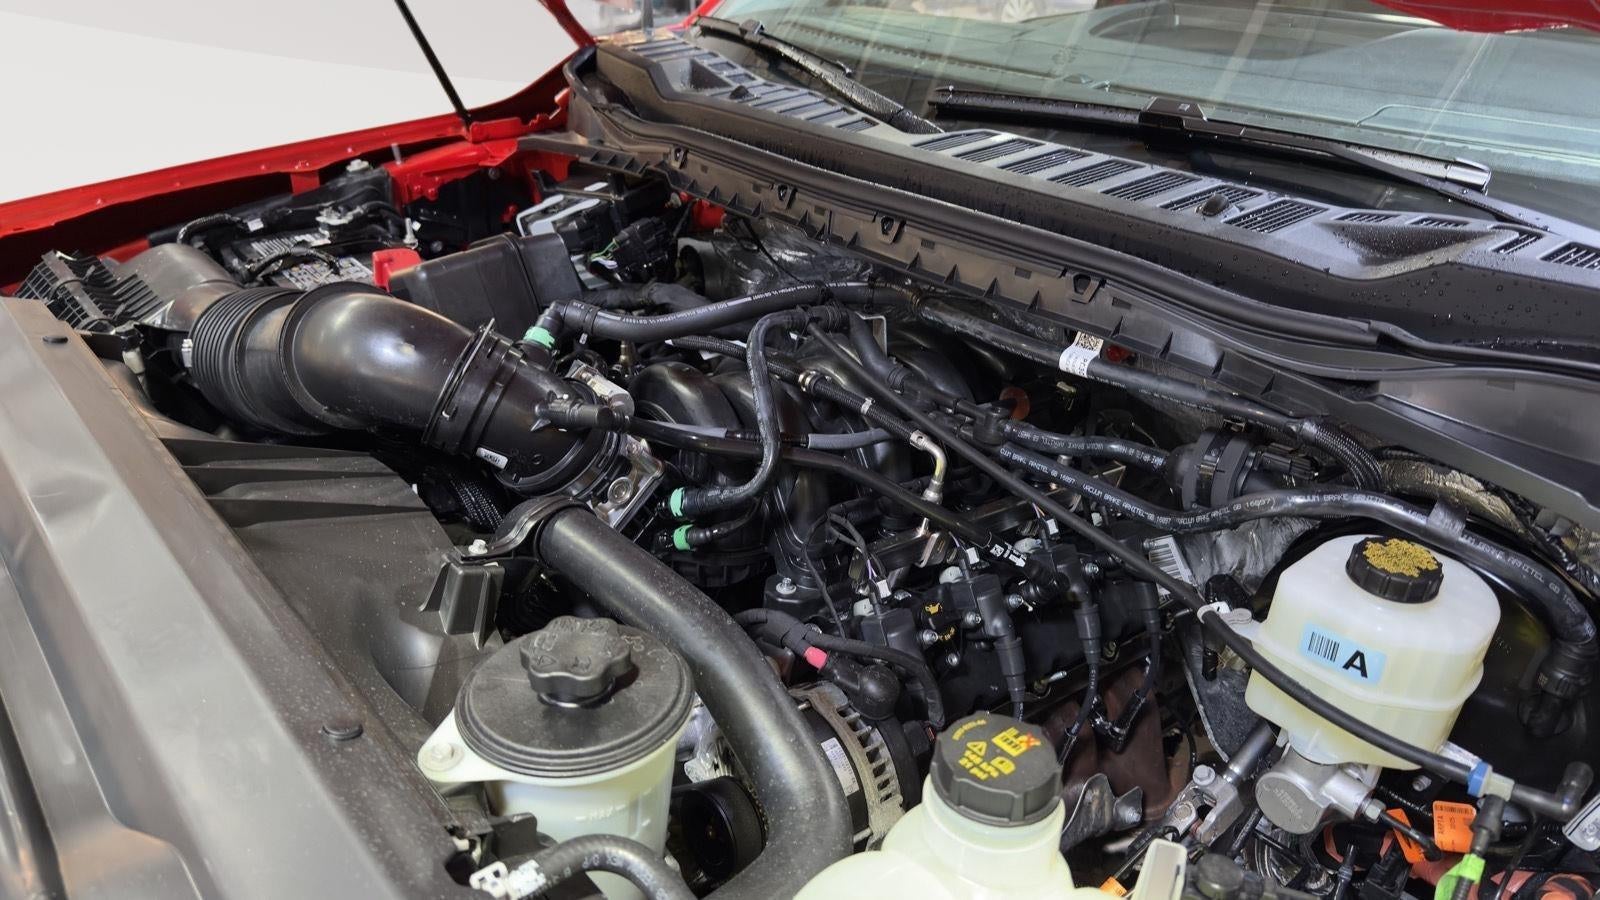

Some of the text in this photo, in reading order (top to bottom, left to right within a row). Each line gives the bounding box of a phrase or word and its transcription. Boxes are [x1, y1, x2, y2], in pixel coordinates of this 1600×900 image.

[1082, 483, 1103, 497] VACUUM
[1103, 493, 1122, 506] BRAKE
[1322, 493, 1349, 502] BRAKE
[1342, 650, 1368, 679] A
